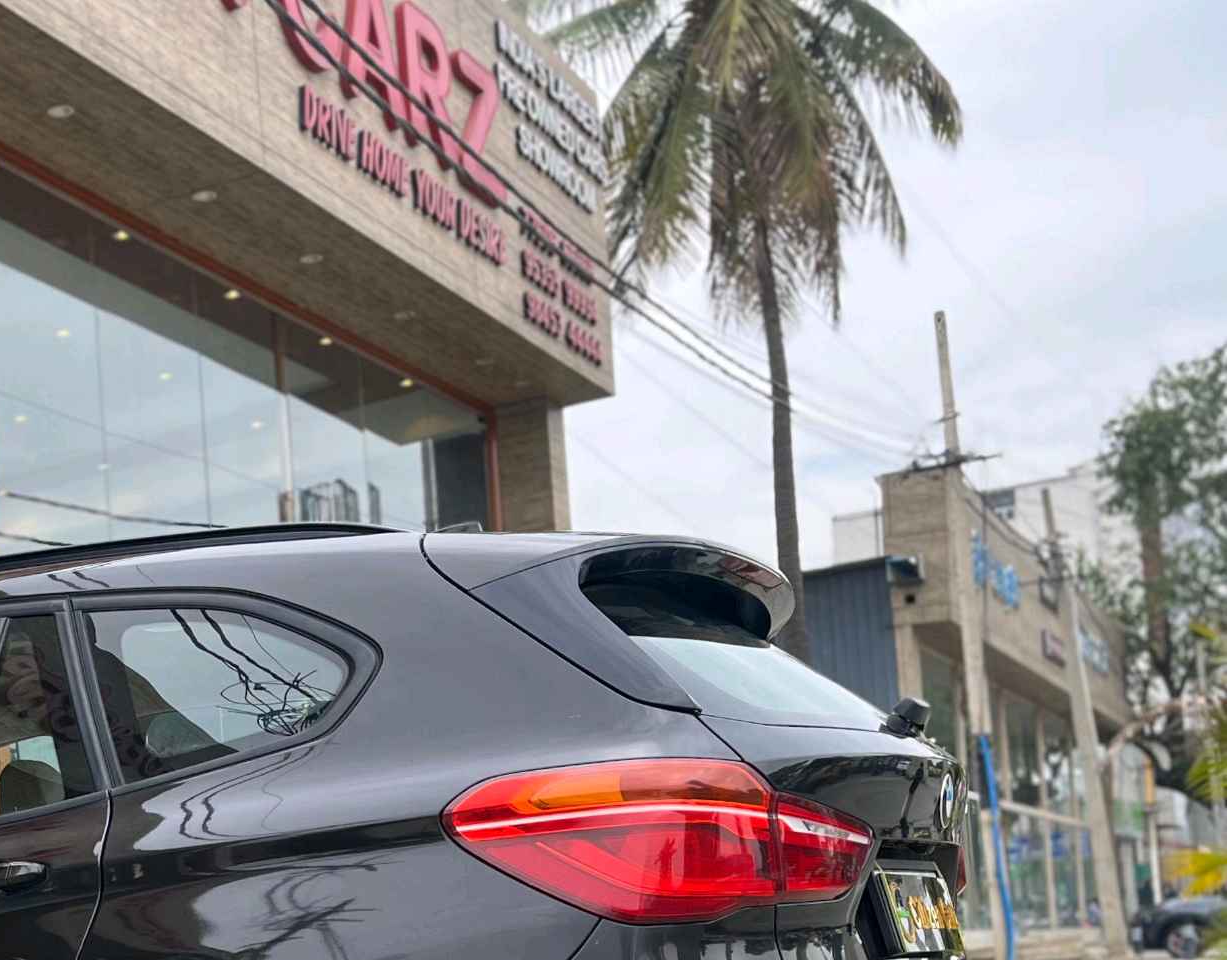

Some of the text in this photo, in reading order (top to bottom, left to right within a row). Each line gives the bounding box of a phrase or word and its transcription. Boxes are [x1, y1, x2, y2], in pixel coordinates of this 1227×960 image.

[299, 84, 355, 162] DRIVE
[357, 129, 411, 198] HOME
[411, 168, 456, 231] YOUR
[456, 198, 507, 267] DESIRE
